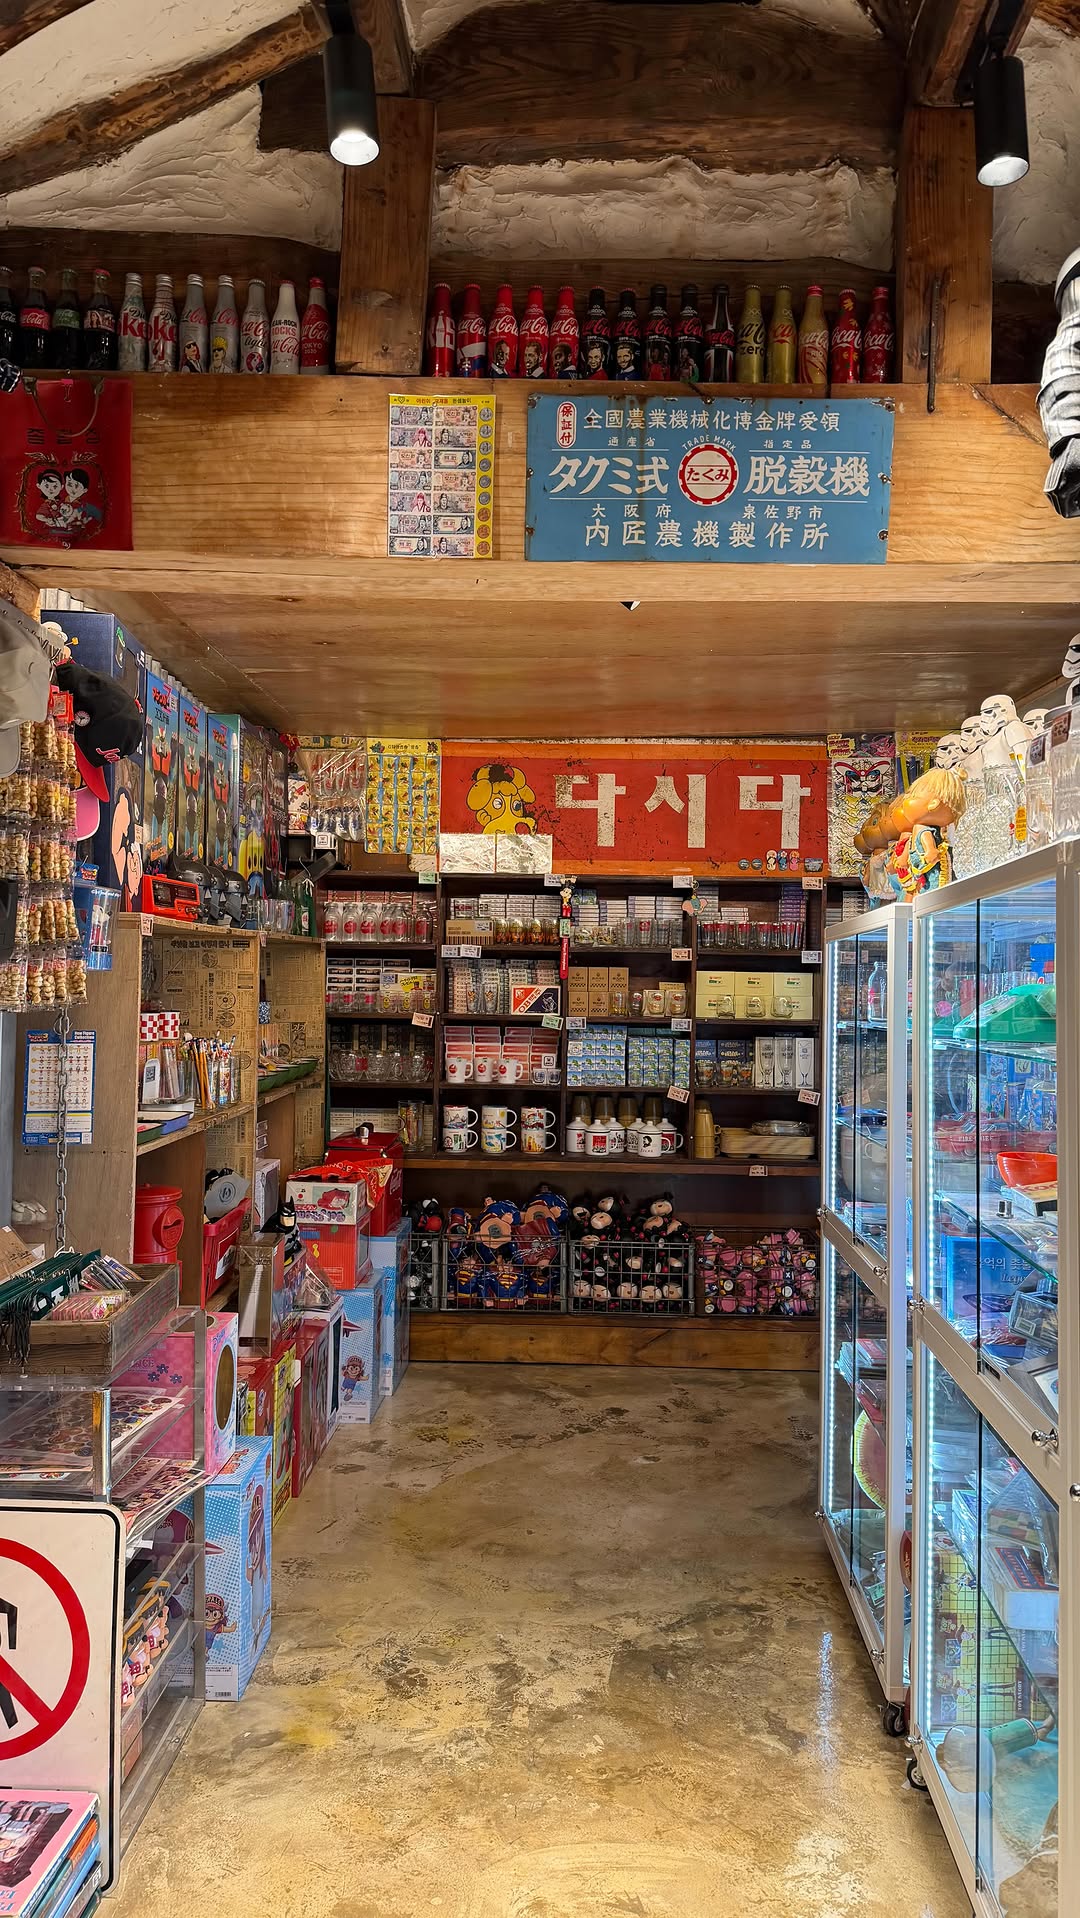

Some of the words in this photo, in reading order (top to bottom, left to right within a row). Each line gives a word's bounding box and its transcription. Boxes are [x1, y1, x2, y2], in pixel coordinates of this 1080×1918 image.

[560, 406, 572, 444] 保証付
[584, 408, 840, 432] 全國農業機械化博金牌受領
[608, 436, 656, 447] 通産省
[682, 434, 710, 450] TRADE
[714, 436, 736, 451] MARK
[764, 440, 812, 449] 指定品
[549, 455, 670, 494] タクミ式
[686, 468, 729, 482] たくみ
[743, 454, 870, 497] 脱穀機
[592, 504, 671, 518] 大阪府
[742, 504, 823, 520] 泉佐野市
[585, 518, 829, 550] 内匠農機製作所
[553, 773, 811, 849] 다시다
